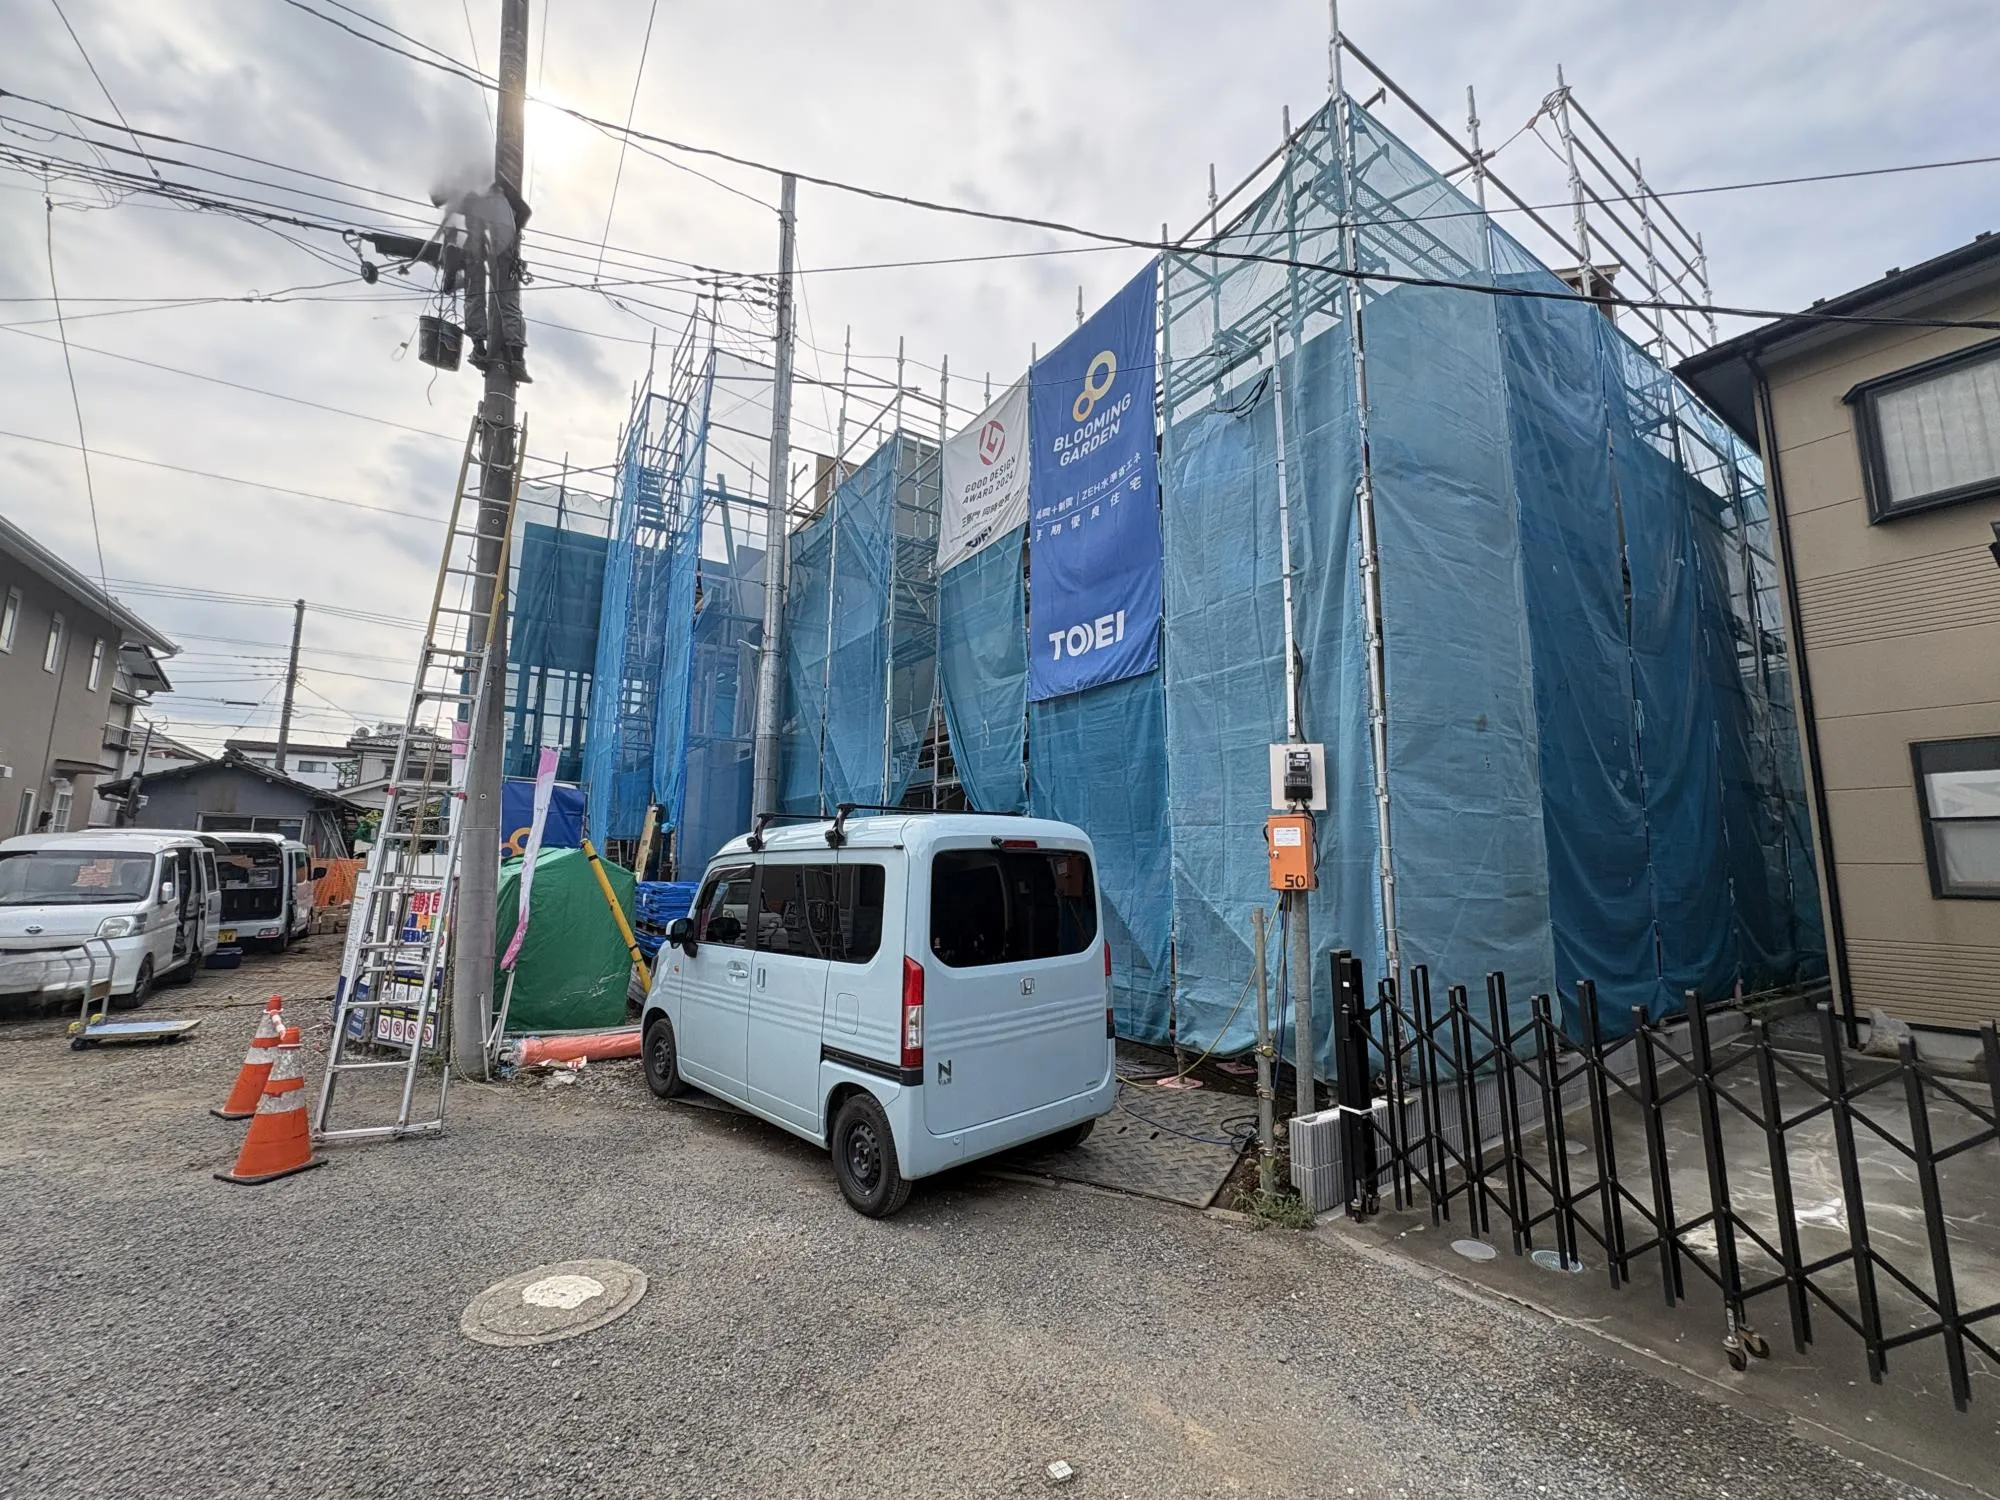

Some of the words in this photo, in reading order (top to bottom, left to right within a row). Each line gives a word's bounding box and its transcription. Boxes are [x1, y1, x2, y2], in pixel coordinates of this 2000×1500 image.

[1053, 392, 1132, 452] BLOOMING
[1060, 418, 1121, 466] GARDEN
[961, 485, 994, 505] AWARD
[995, 470, 1014, 491] 2024
[964, 476, 988, 494] GOOD
[989, 454, 1016, 482] DESIGN
[1048, 609, 1126, 661] TOEI
[1284, 873, 1306, 888] 50
[937, 1059, 952, 1079] N
